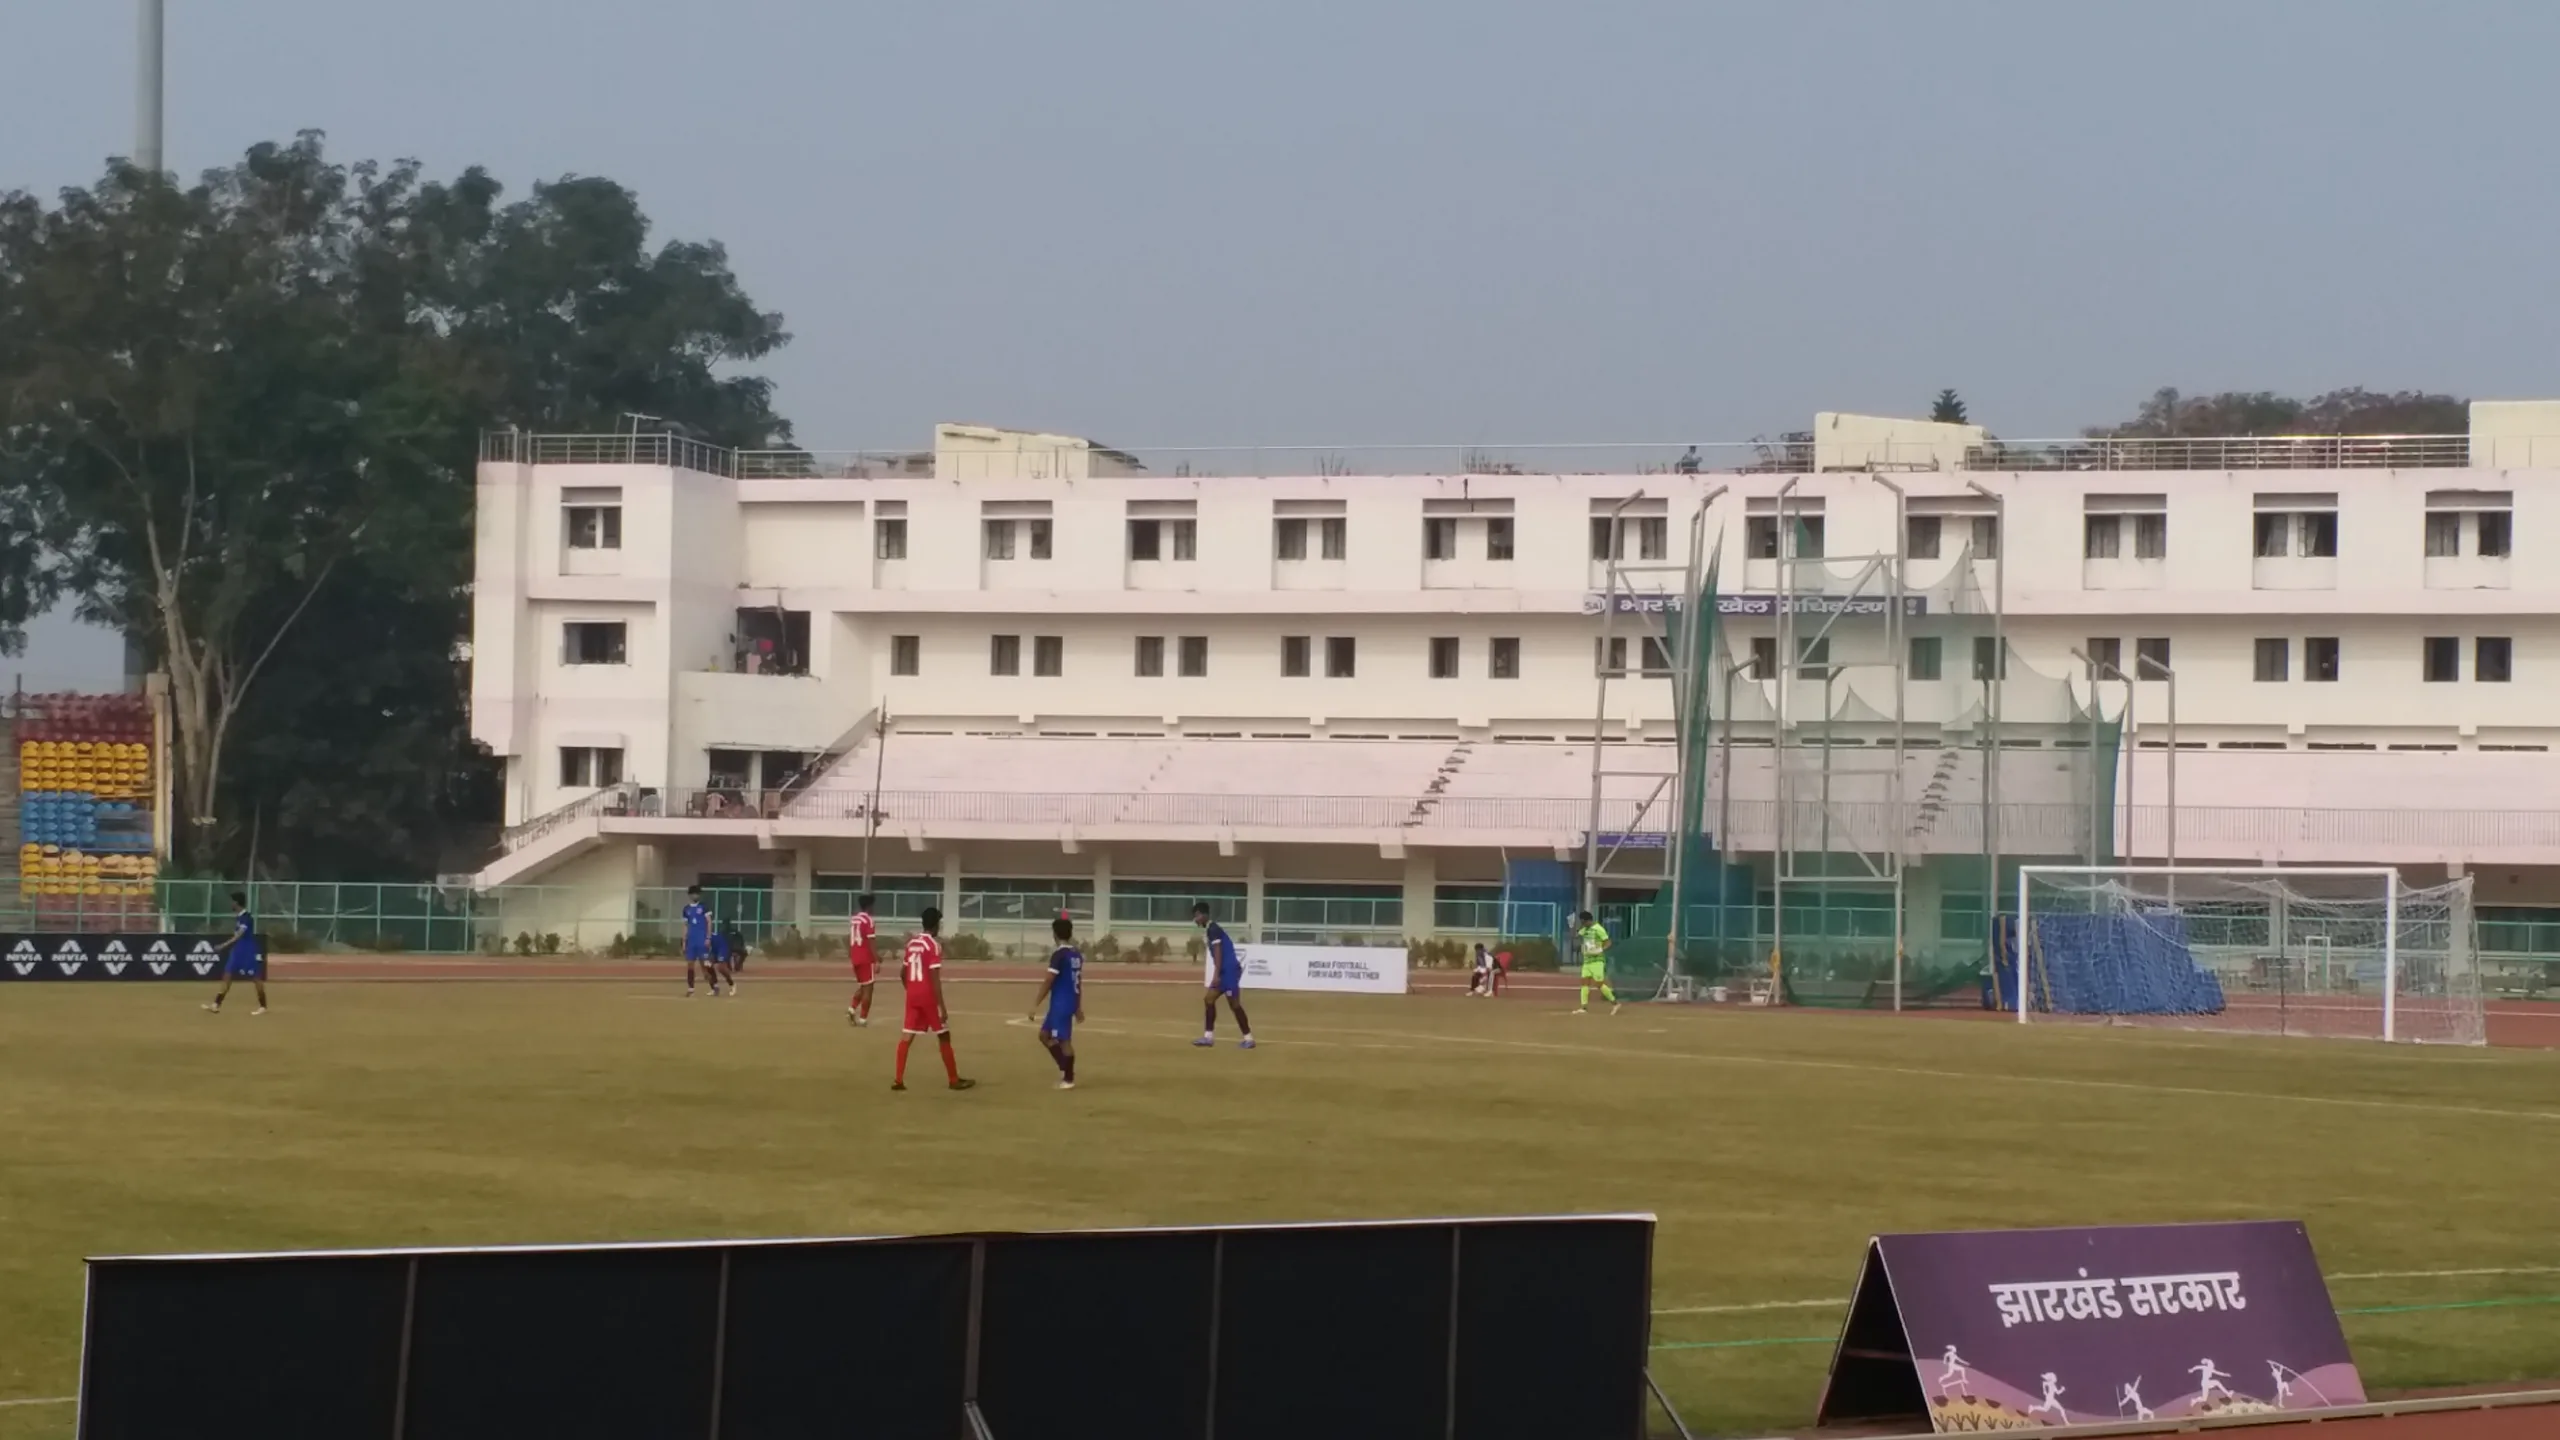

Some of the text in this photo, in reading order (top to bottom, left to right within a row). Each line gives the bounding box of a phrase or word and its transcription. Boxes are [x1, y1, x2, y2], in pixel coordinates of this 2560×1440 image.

[1718, 596, 1770, 613] खेल
[6, 953, 42, 962] NIVIA
[51, 953, 88, 962] NIVIA
[97, 953, 133, 962] NIVIA
[142, 953, 177, 962] NIVIA
[185, 953, 221, 962] NIVIA
[908, 953, 923, 982] 11
[1332, 960, 1369, 970] FOOTBALL
[1307, 970, 1380, 980] FORWARD TOGETHER
[1988, 1267, 2246, 1328] झारखंड सरकार
